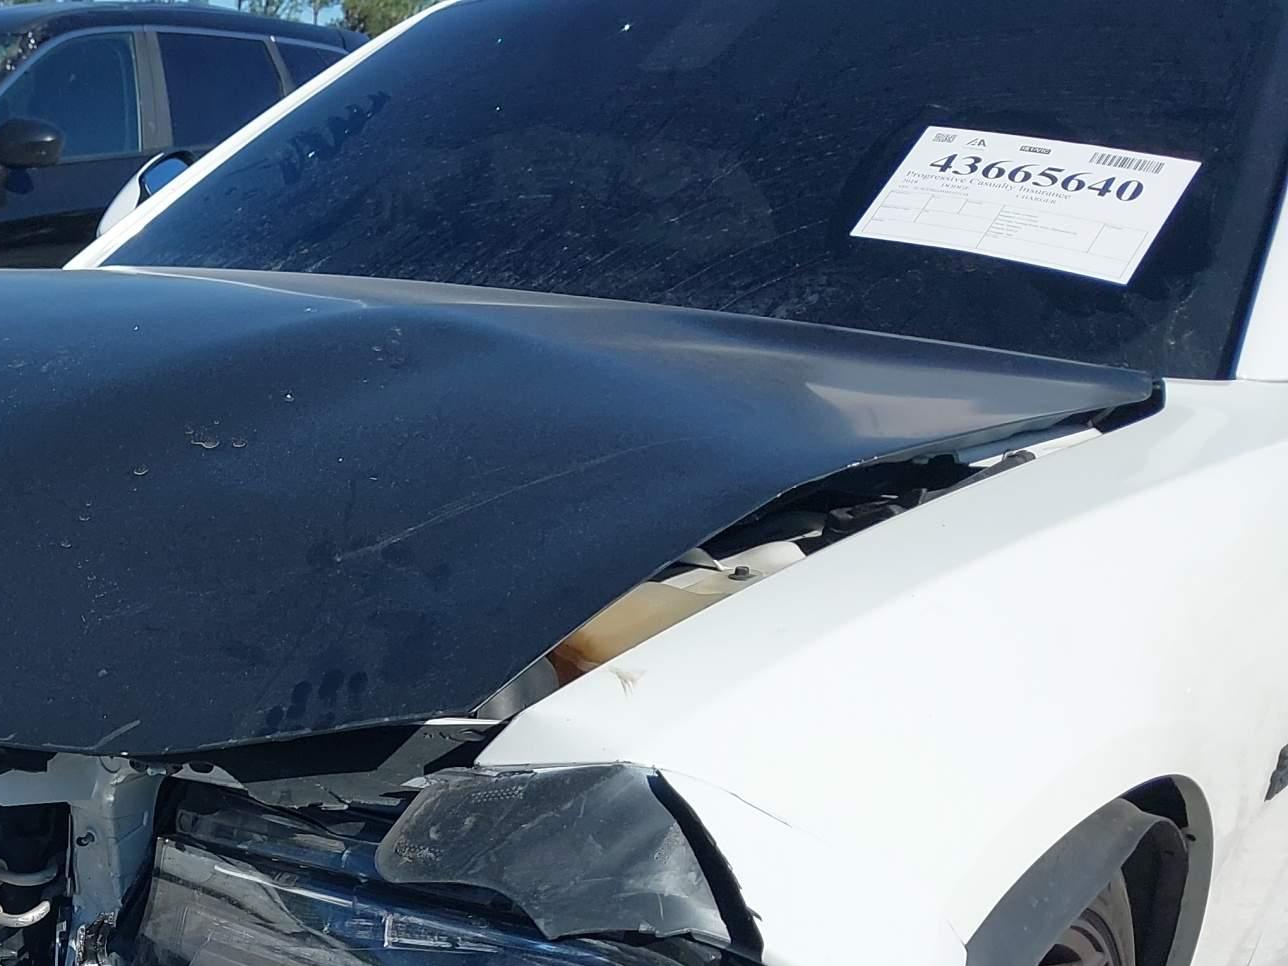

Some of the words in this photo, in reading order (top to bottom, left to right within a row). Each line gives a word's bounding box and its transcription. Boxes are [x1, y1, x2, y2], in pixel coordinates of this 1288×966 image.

[905, 170, 968, 184] Progressive
[969, 178, 1014, 191] Casualty
[1018, 185, 1072, 201] Insurance
[929, 152, 1144, 202] 43665640
